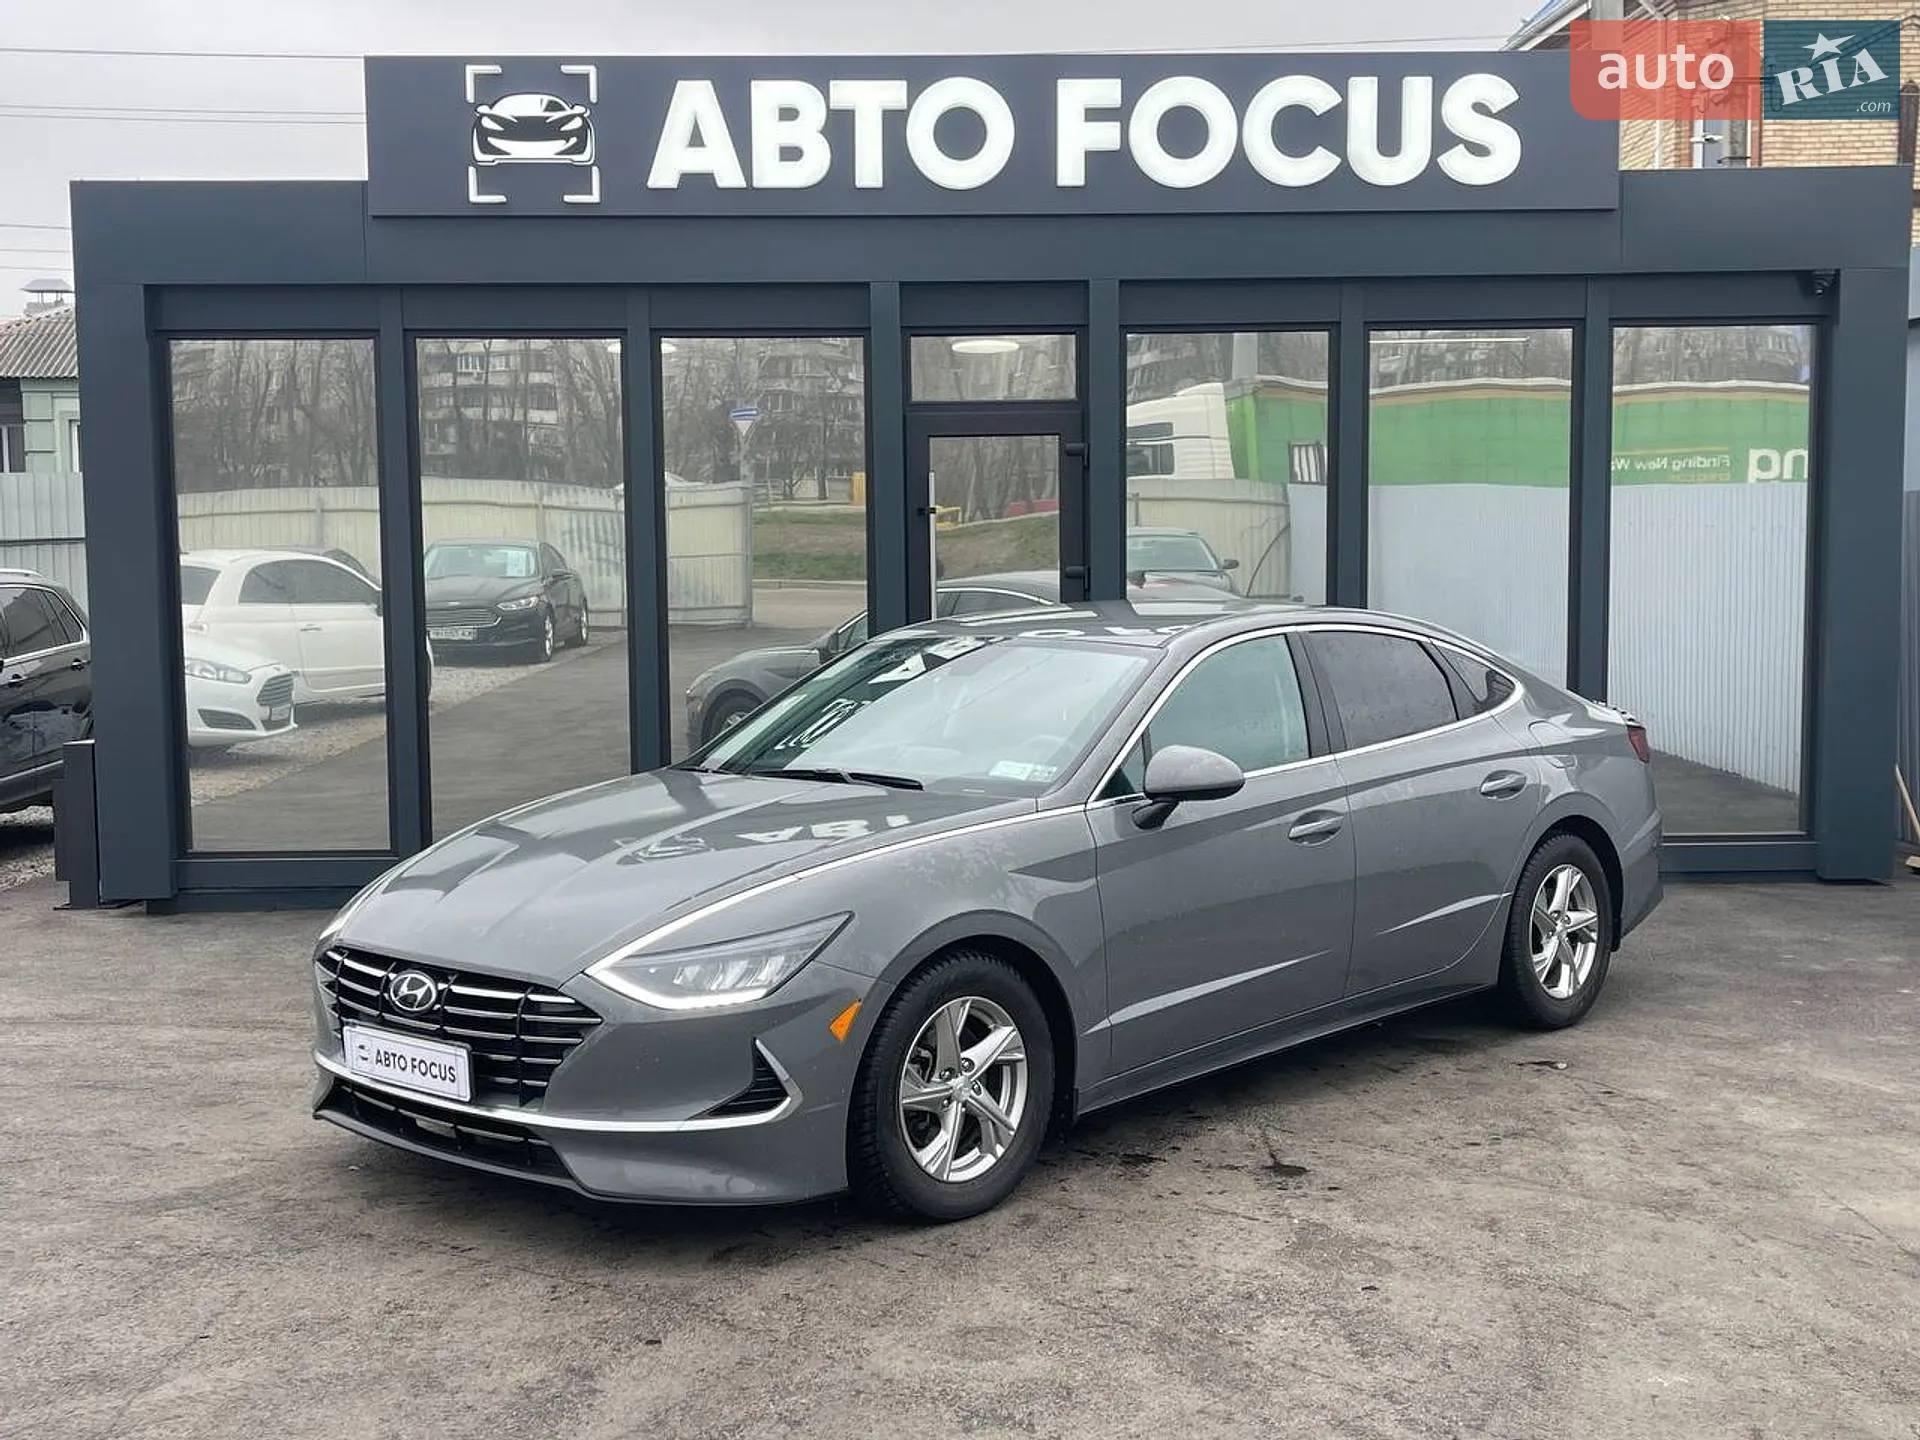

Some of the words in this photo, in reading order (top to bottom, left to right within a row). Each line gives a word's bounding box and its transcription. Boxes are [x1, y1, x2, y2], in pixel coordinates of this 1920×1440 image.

[646, 76, 1015, 190] АВТО
[1056, 73, 1522, 189] FOCUS
[375, 1049, 408, 1072] АВТО
[411, 1057, 456, 1083] FOCUS
